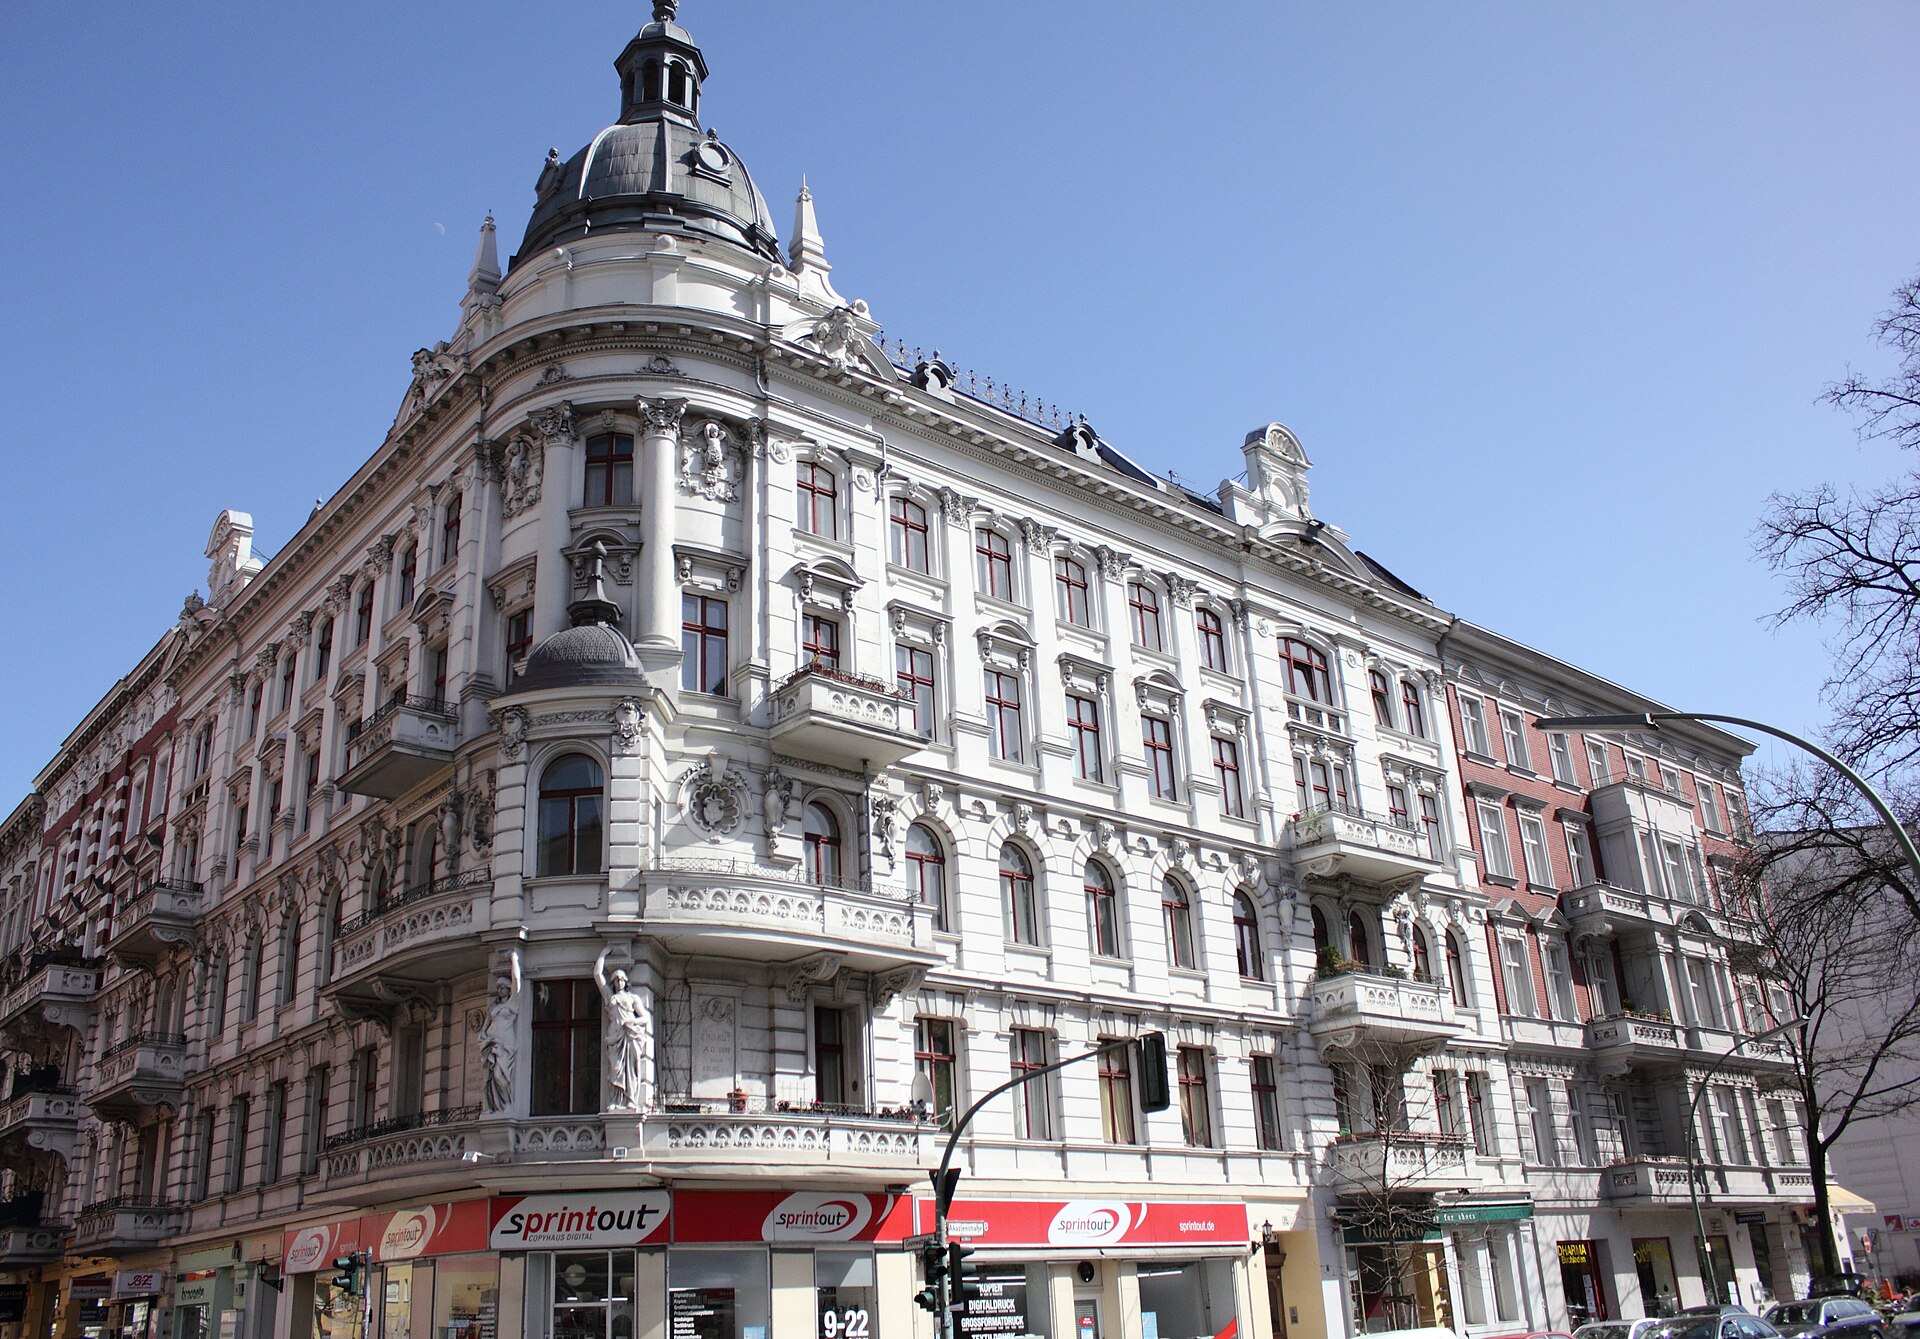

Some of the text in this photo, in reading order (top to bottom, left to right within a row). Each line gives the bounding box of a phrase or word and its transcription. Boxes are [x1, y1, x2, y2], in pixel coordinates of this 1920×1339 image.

[500, 1204, 659, 1241] sprintout
[775, 1211, 846, 1229] sprintout
[1443, 1213, 1454, 1221] for
[1058, 1218, 1111, 1234] sprintout
[1179, 1220, 1215, 1233] sprintout.de
[1362, 1225, 1401, 1239] Oxfod
[385, 1226, 420, 1246] sprintout
[528, 1233, 593, 1242] COPYHAUS DIGITAL
[290, 1244, 318, 1262] sprintout
[1556, 1243, 1587, 1257] DHARMA
[968, 1299, 1015, 1310] DIGITALDRUCK
[824, 1309, 869, 1338] 9-22
[961, 1315, 1024, 1328] GROSSFORMATDRUCK
